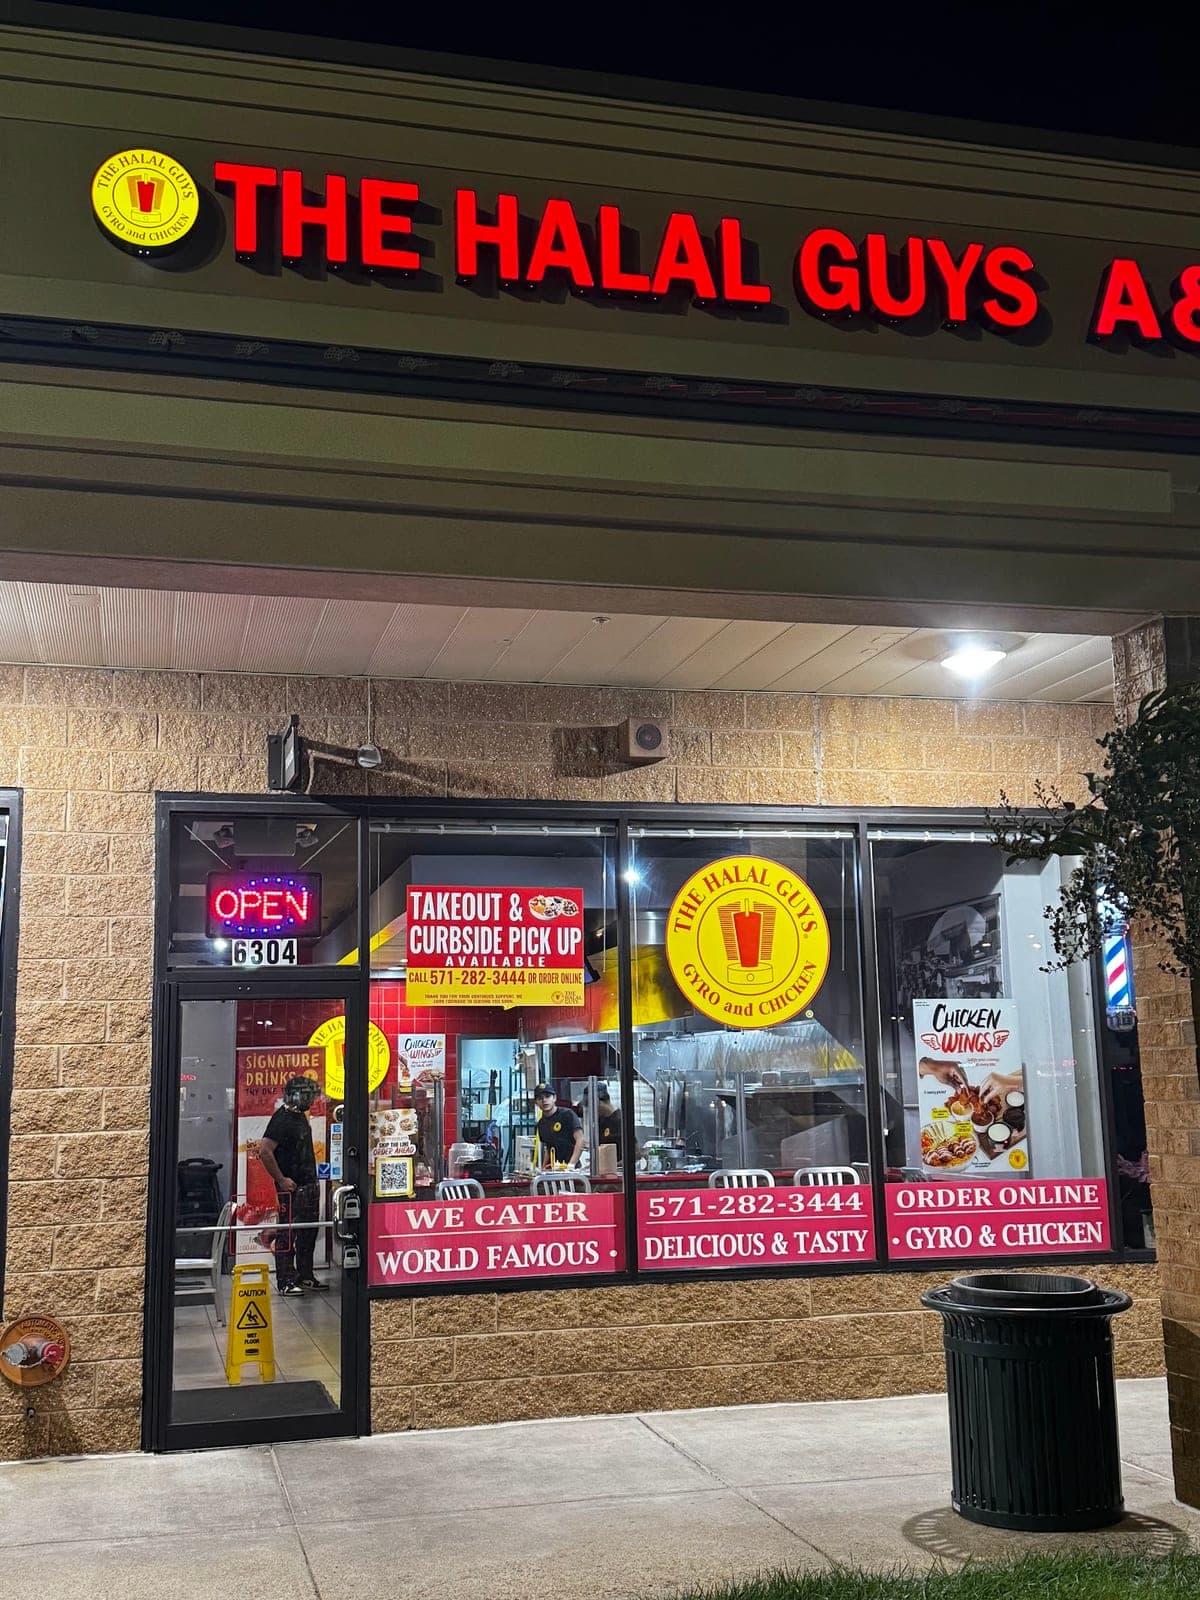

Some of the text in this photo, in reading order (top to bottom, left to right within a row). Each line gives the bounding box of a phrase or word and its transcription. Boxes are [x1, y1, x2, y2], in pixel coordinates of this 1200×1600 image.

[97, 153, 194, 199] THE HALAL GUYS
[102, 205, 189, 241] GYRO and CHICKEN
[214, 161, 421, 271] THE
[455, 189, 771, 304] HALAL
[800, 228, 1038, 327] GUYS
[214, 889, 308, 920] OPEN
[410, 891, 523, 922] TAKEOUT &
[674, 865, 818, 934] THE HALAL GUYS
[233, 939, 296, 965] 6304
[410, 925, 582, 955] CURBSIDE PICK UP
[445, 956, 546, 967] AVAILABLE
[409, 970, 582, 985] CALL 571-282-3444 OR ORDER ONLINE
[683, 960, 817, 1016] GYRO and CHICKEN
[932, 1003, 1001, 1033] CHICKEN
[941, 1032, 993, 1054] WINGS
[246, 1053, 320, 1069] SIGNATURE
[648, 1192, 863, 1217] 571-282-3444
[896, 1184, 1099, 1209] ORDER ONLINE
[405, 1202, 588, 1230] WE CATER
[644, 1230, 868, 1260] DELICIOUS & TASTY
[905, 1221, 1103, 1250] GYRO & CHICKEN
[376, 1240, 599, 1276] WORLD FAMOUS
[239, 1288, 266, 1297] CAUTION
